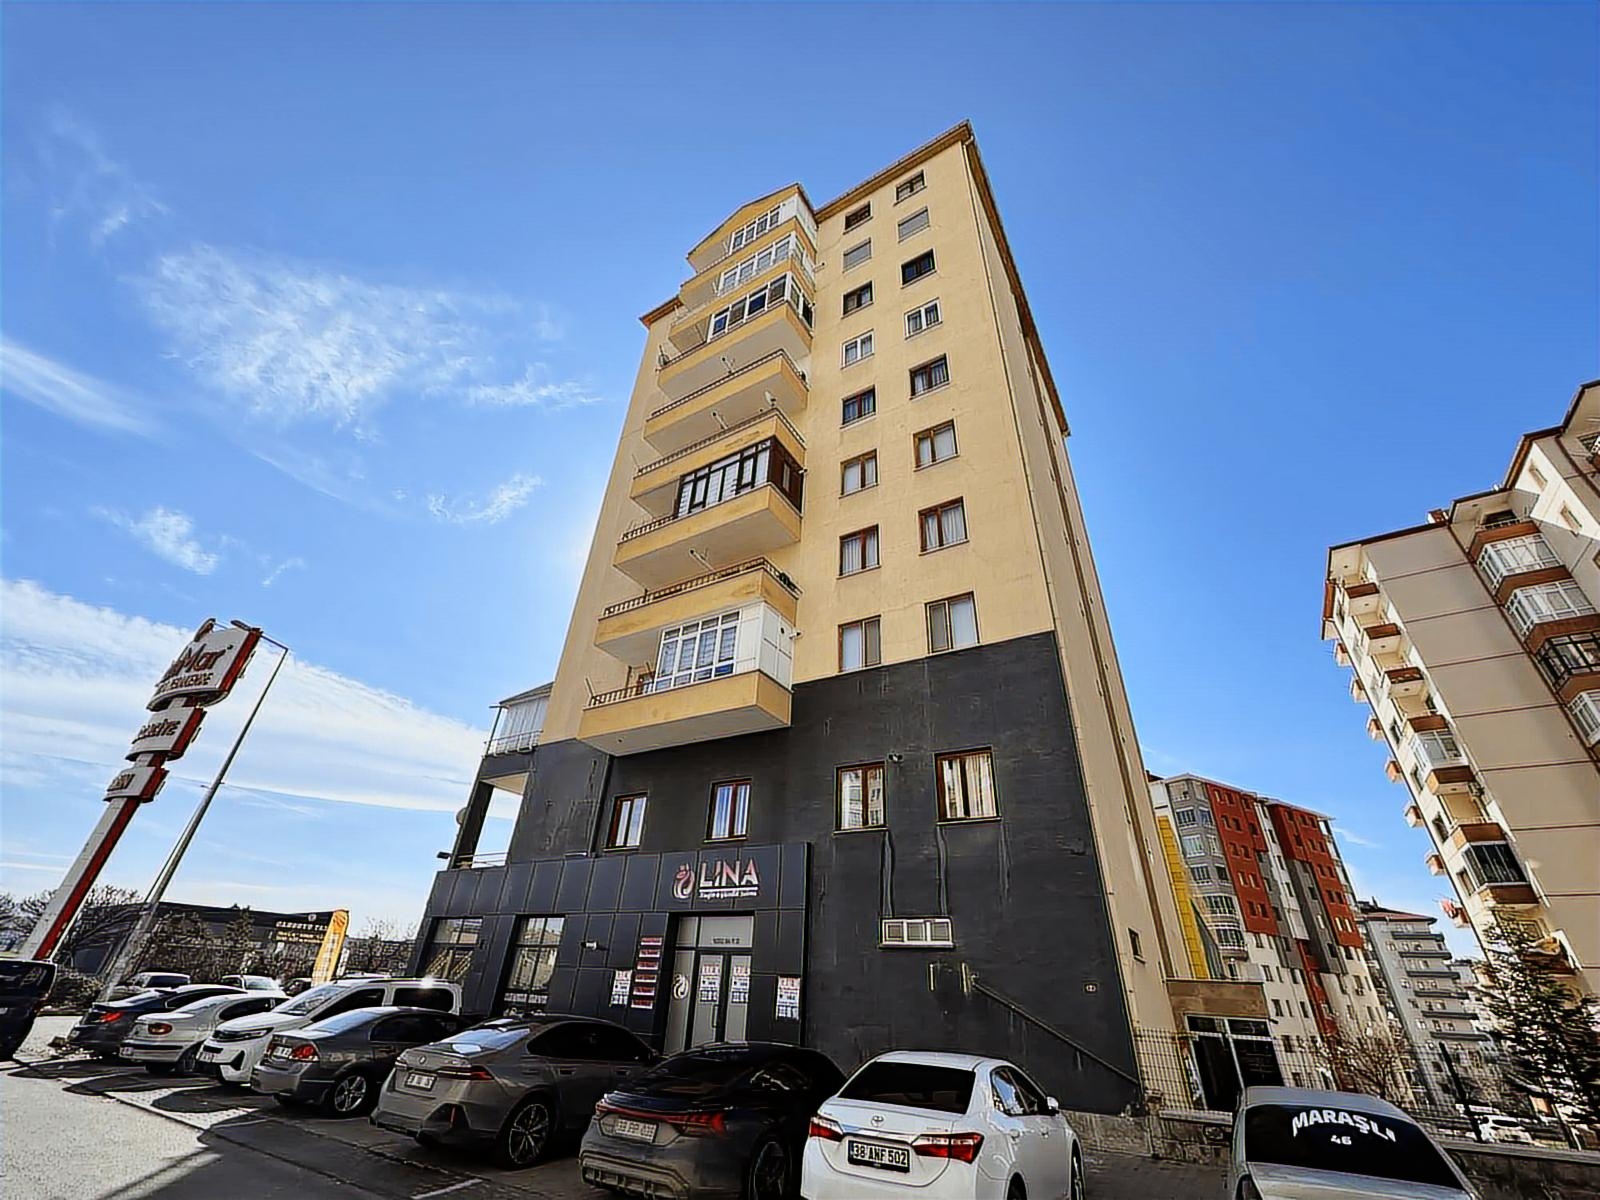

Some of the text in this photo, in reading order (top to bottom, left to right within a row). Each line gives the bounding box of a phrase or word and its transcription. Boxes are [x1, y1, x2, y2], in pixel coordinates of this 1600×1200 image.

[700, 859, 758, 887] LINA
[1292, 1109, 1396, 1143] MARAŞLI
[1330, 1135, 1352, 1145] 46
[854, 1144, 866, 1158] 38
[888, 1149, 907, 1166] 502
